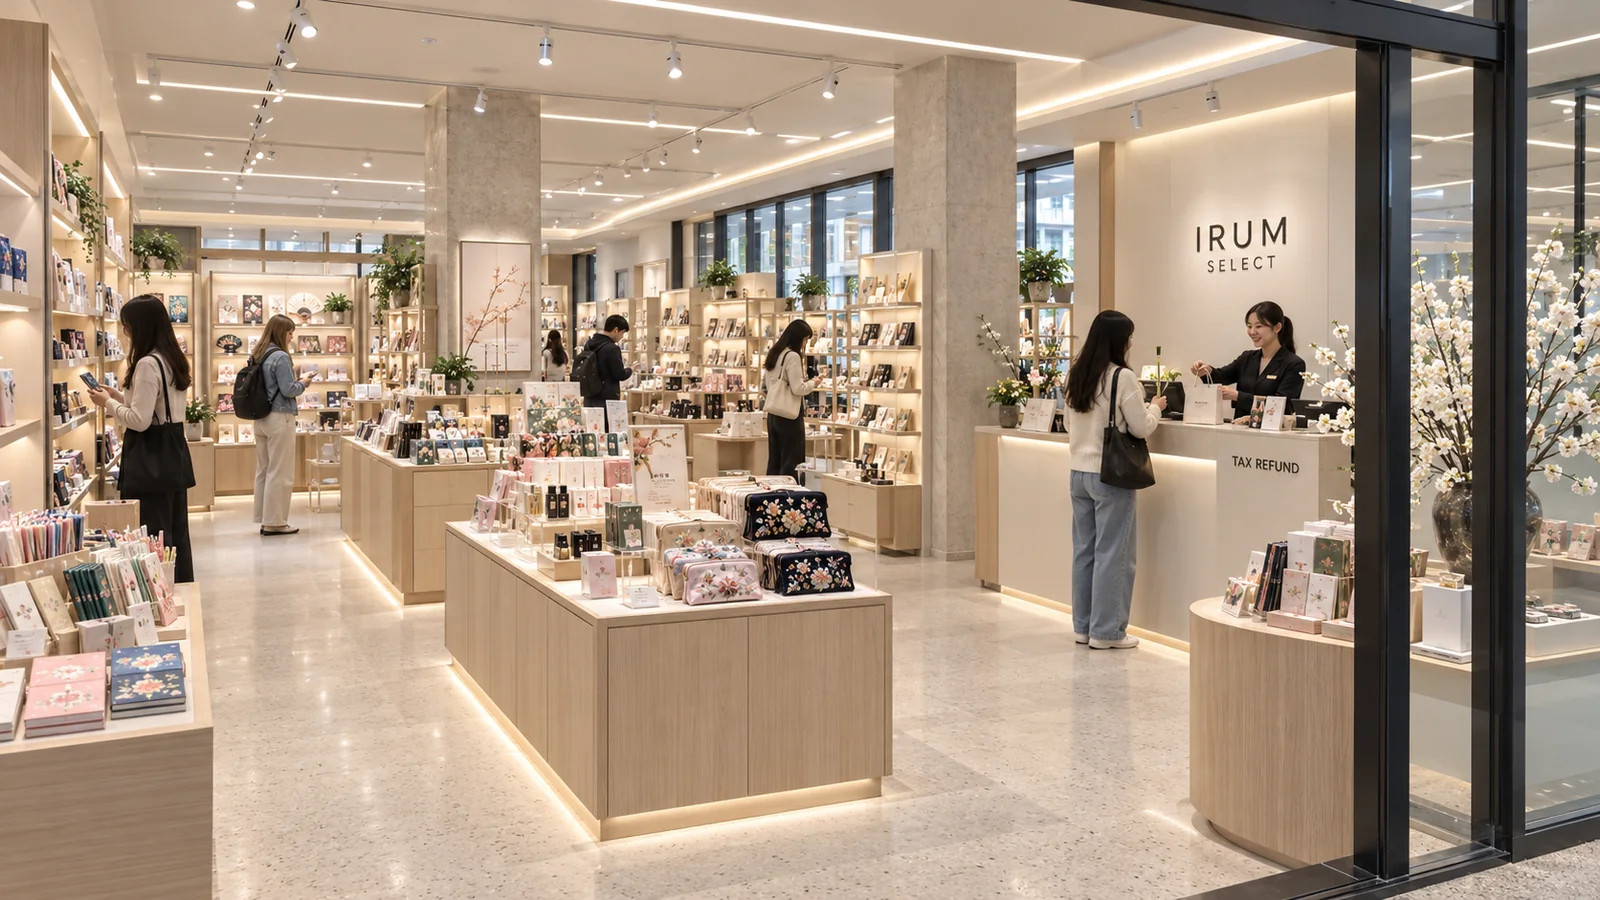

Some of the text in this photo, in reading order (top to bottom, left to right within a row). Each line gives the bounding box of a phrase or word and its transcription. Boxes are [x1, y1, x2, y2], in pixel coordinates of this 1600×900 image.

[1197, 216, 1287, 253] IRUM
[1207, 255, 1276, 273] SELECT
[1232, 455, 1300, 474] TAX REFUND
